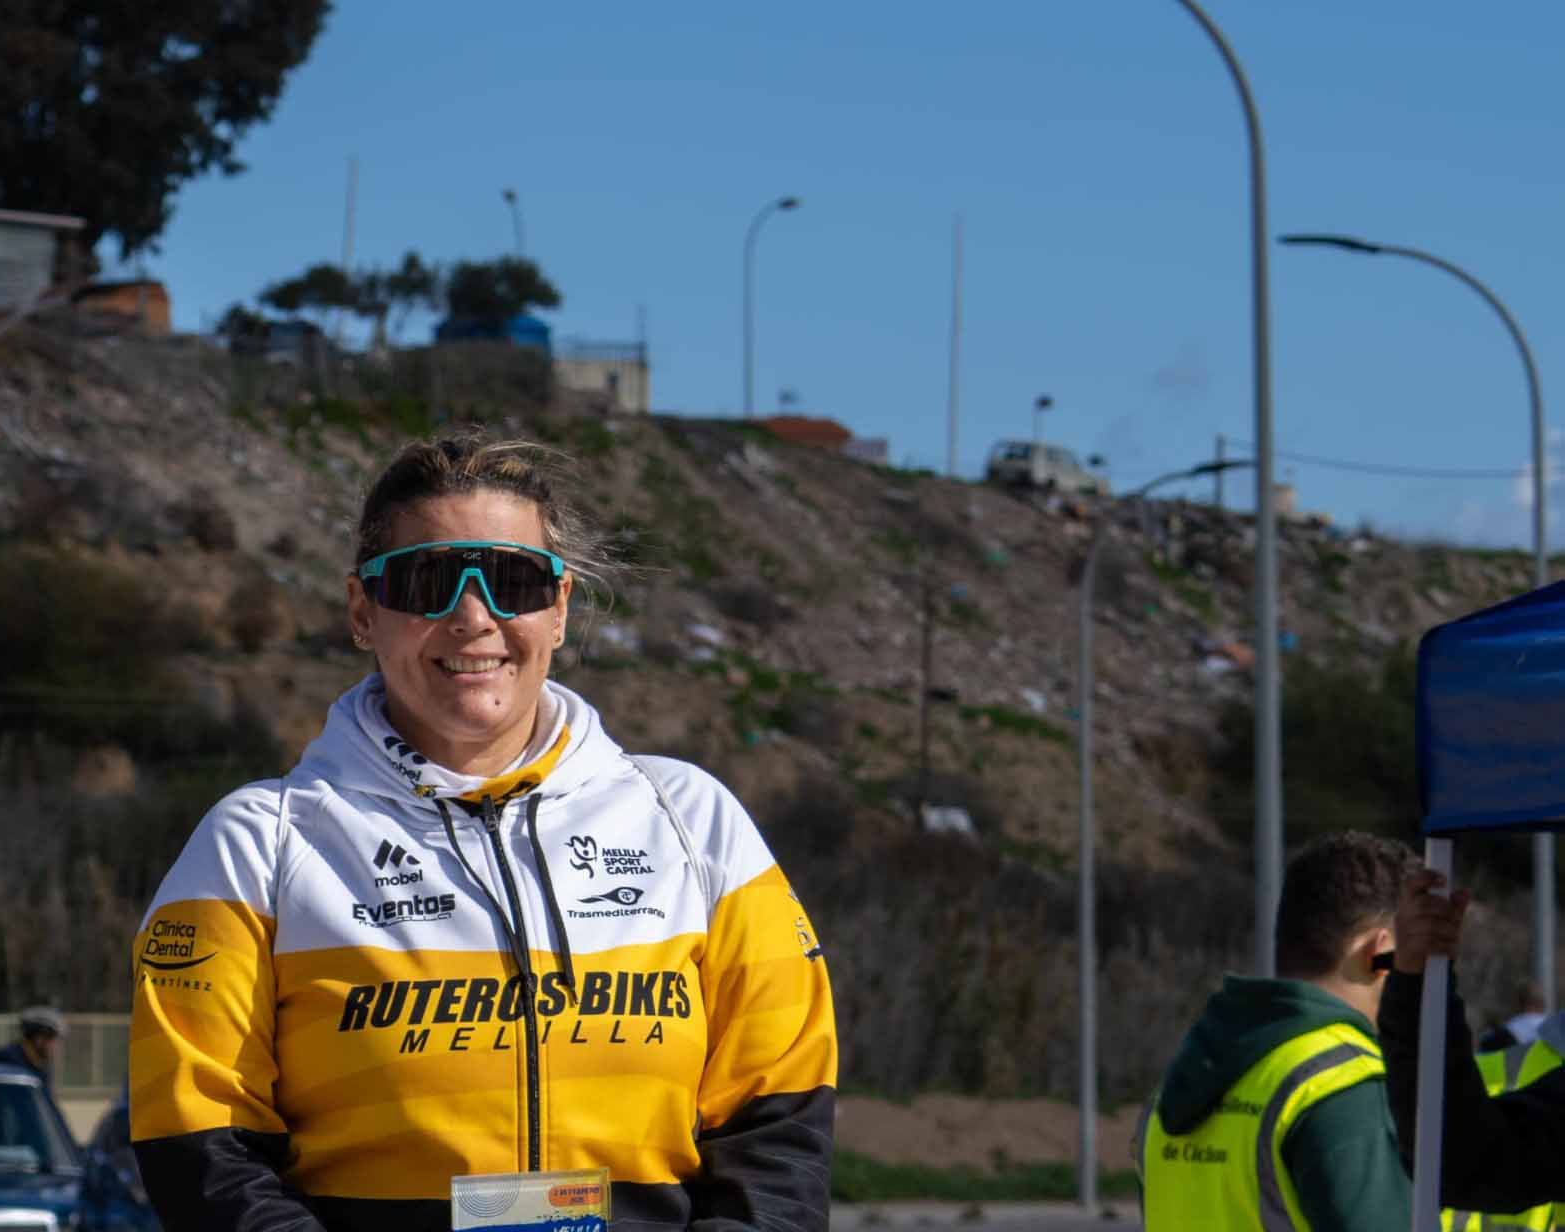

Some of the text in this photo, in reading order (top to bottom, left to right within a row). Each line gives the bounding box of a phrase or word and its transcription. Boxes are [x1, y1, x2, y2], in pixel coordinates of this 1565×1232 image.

[602, 848, 648, 857] MELILLA
[603, 857, 641, 866] SPORT
[375, 869, 424, 888] mobel
[607, 865, 655, 876] CAPITAL
[352, 893, 456, 922] Eventos
[145, 939, 194, 957] Dental
[338, 971, 691, 1033] RUTEROS BIKES
[400, 1020, 664, 1054] MELILLA
